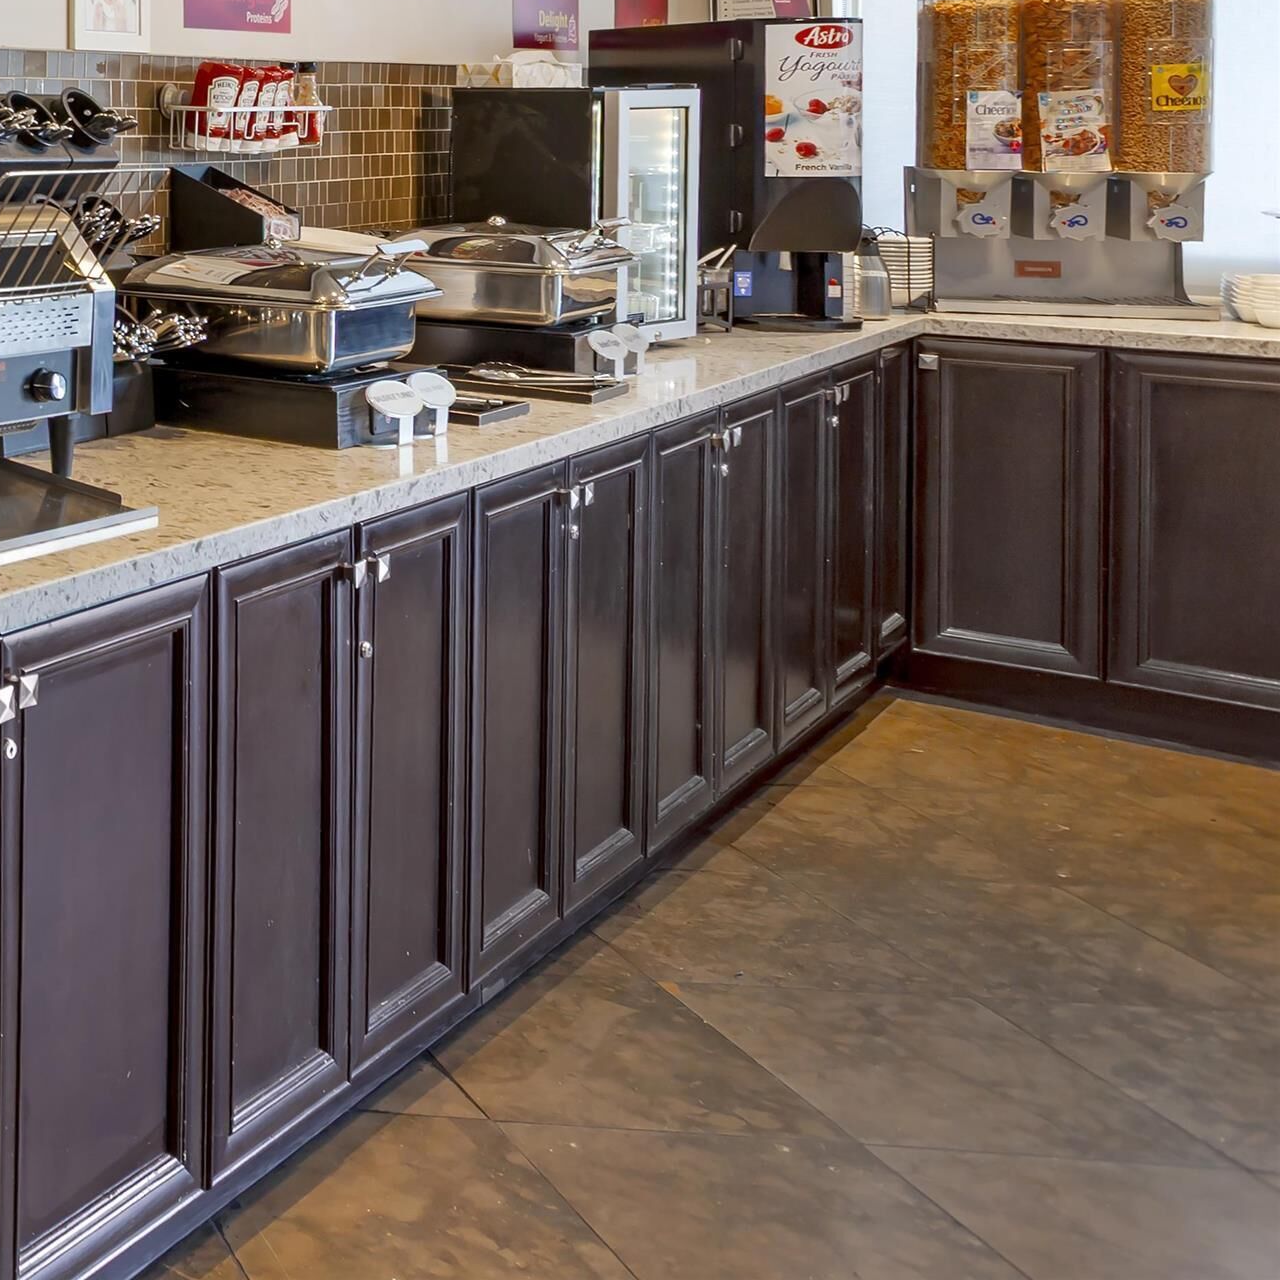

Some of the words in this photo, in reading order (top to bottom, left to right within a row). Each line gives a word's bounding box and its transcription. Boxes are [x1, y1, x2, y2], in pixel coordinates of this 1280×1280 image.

[246, 11, 272, 24] Proteins
[539, 10, 569, 33] Delight
[795, 163, 828, 171] French
